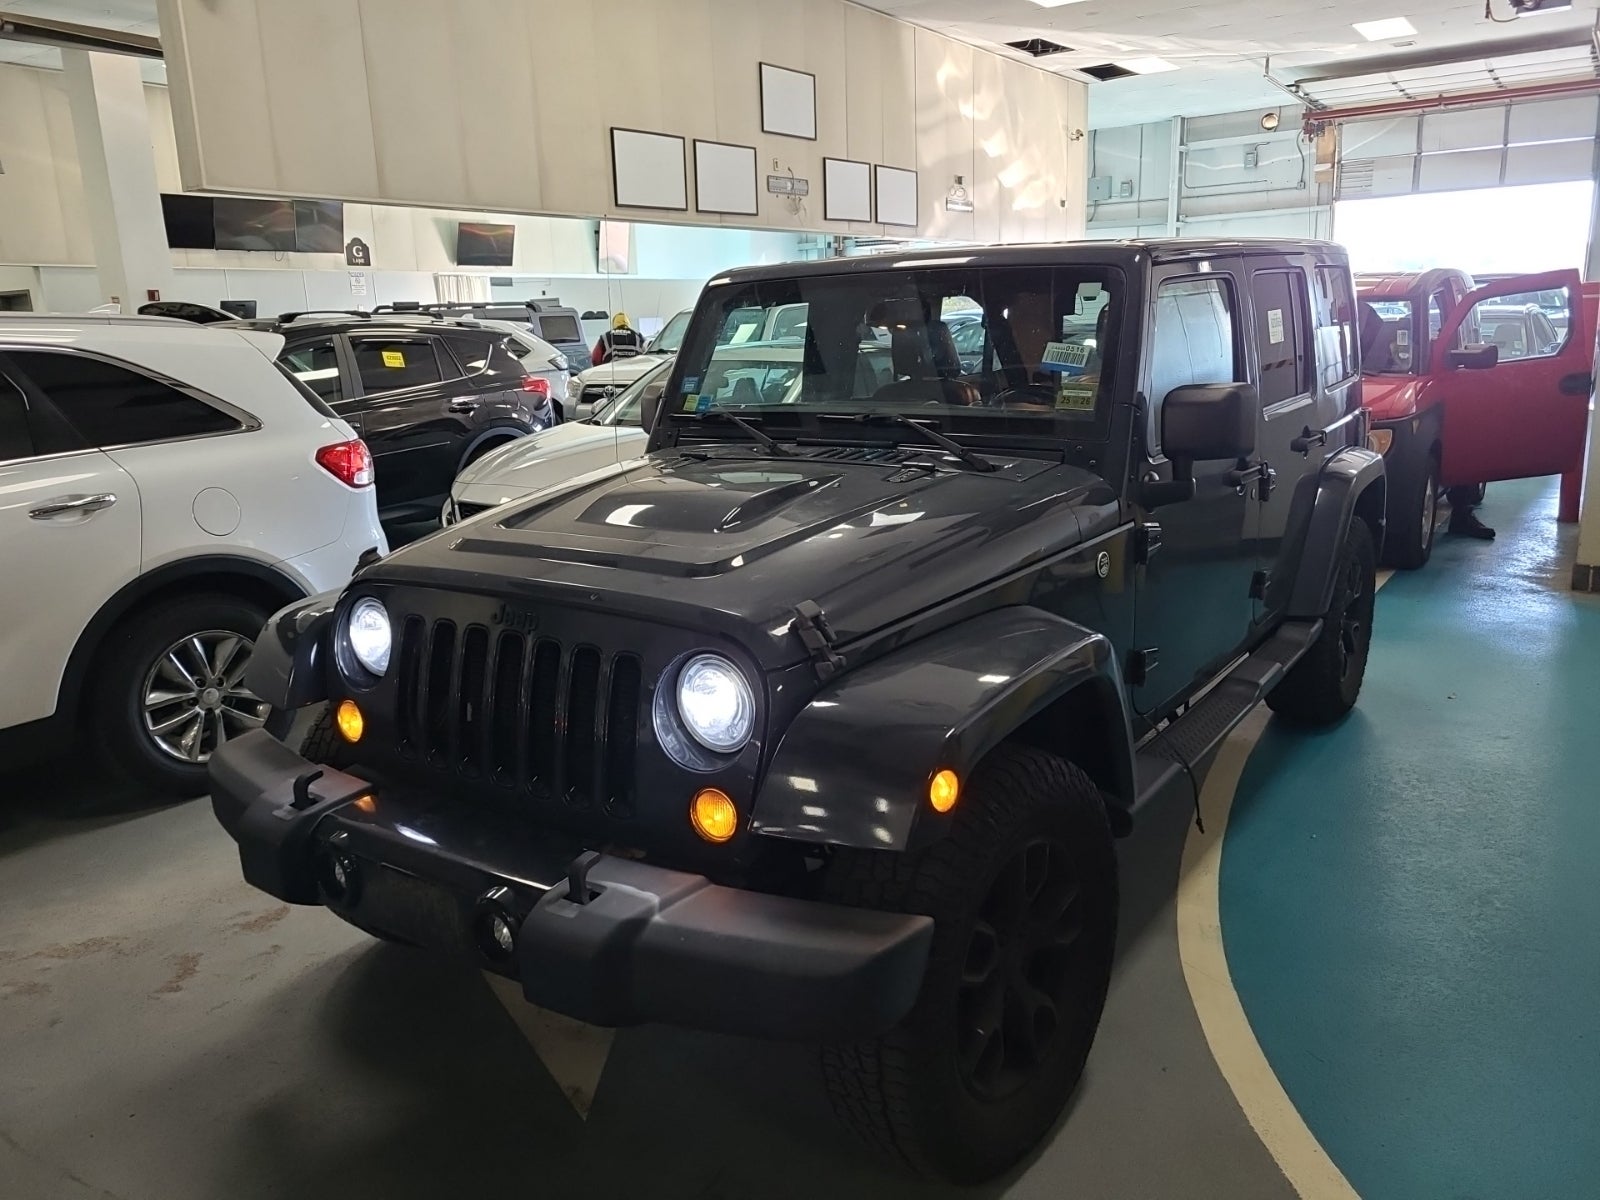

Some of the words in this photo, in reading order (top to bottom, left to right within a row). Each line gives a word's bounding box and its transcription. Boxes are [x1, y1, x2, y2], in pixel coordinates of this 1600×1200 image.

[352, 245, 363, 257] G
[1061, 396, 1071, 404] 25
[490, 602, 539, 635] Jeep
